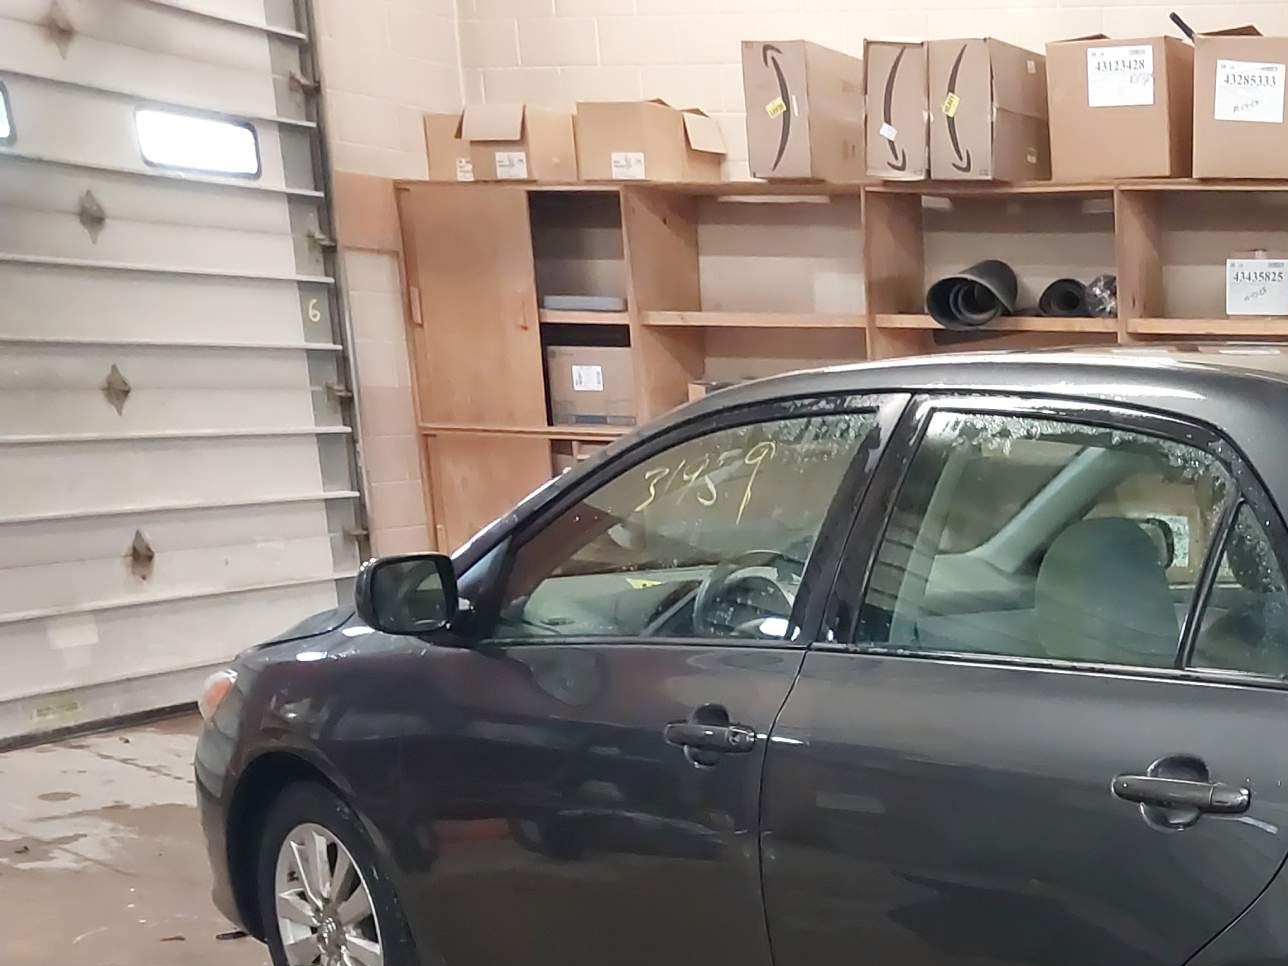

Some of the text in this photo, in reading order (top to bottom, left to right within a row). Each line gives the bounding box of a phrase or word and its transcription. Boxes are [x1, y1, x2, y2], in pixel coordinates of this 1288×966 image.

[1096, 59, 1145, 72] 43123428
[1223, 73, 1277, 87] 43285333
[1233, 271, 1284, 283] 43435825
[308, 299, 320, 322] 6
